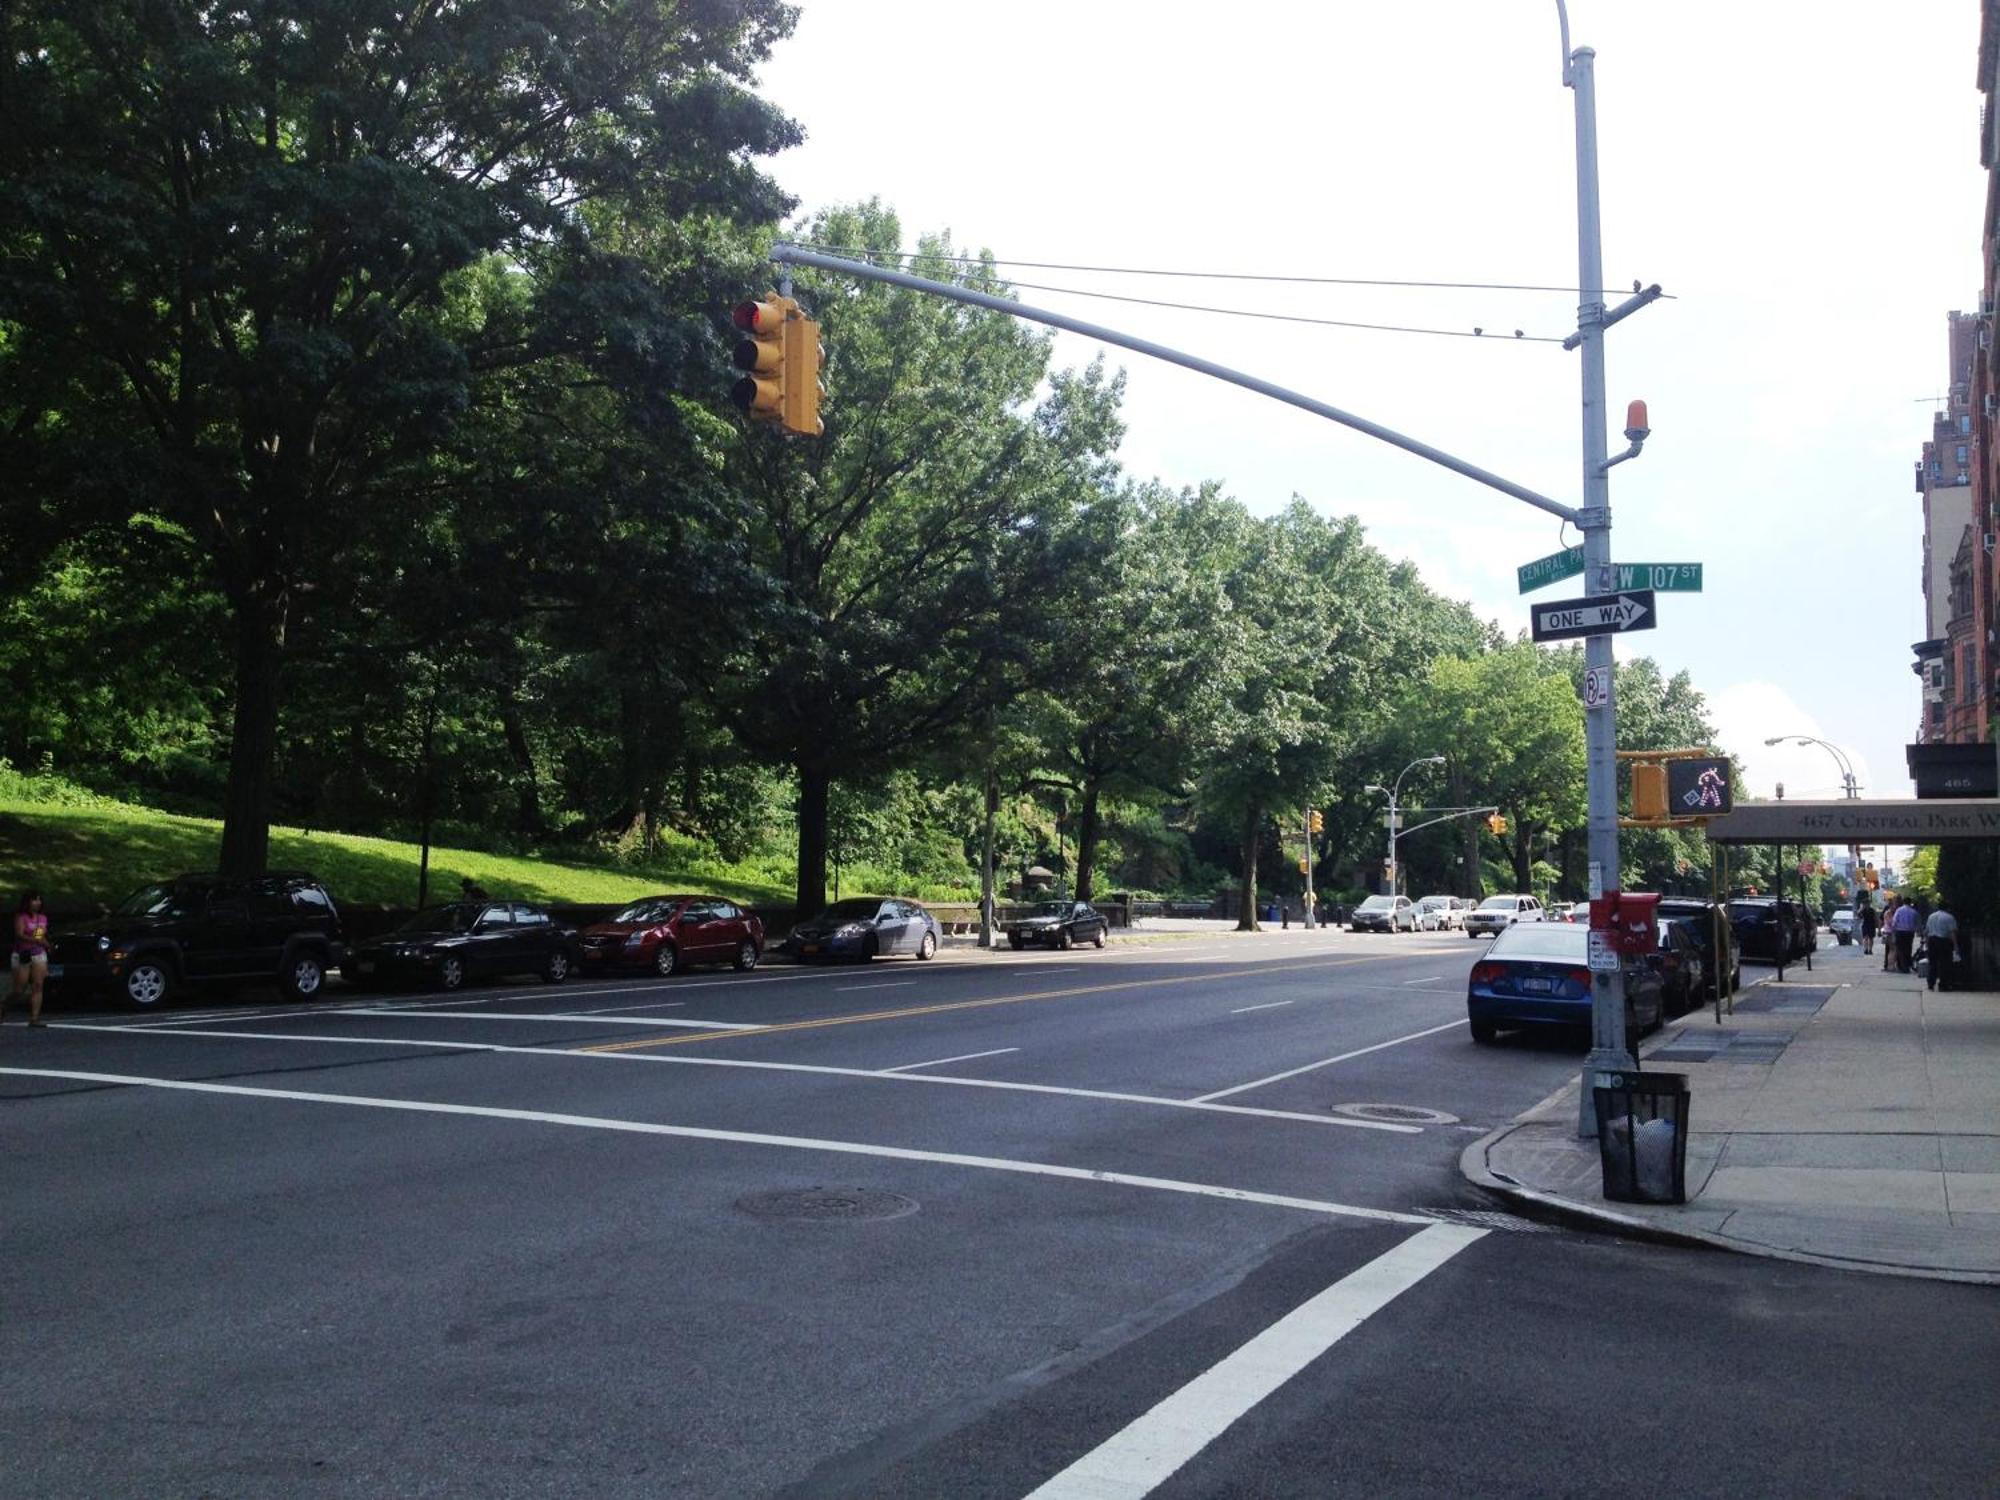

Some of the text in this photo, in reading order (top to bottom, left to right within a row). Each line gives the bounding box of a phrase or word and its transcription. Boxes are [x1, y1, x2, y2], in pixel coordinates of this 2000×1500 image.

[1521, 554, 1565, 582] CENTRAL
[1620, 566, 1697, 588] W 107 ST
[1549, 604, 1635, 628] ONE WAY
[1799, 814, 1833, 828] 467
